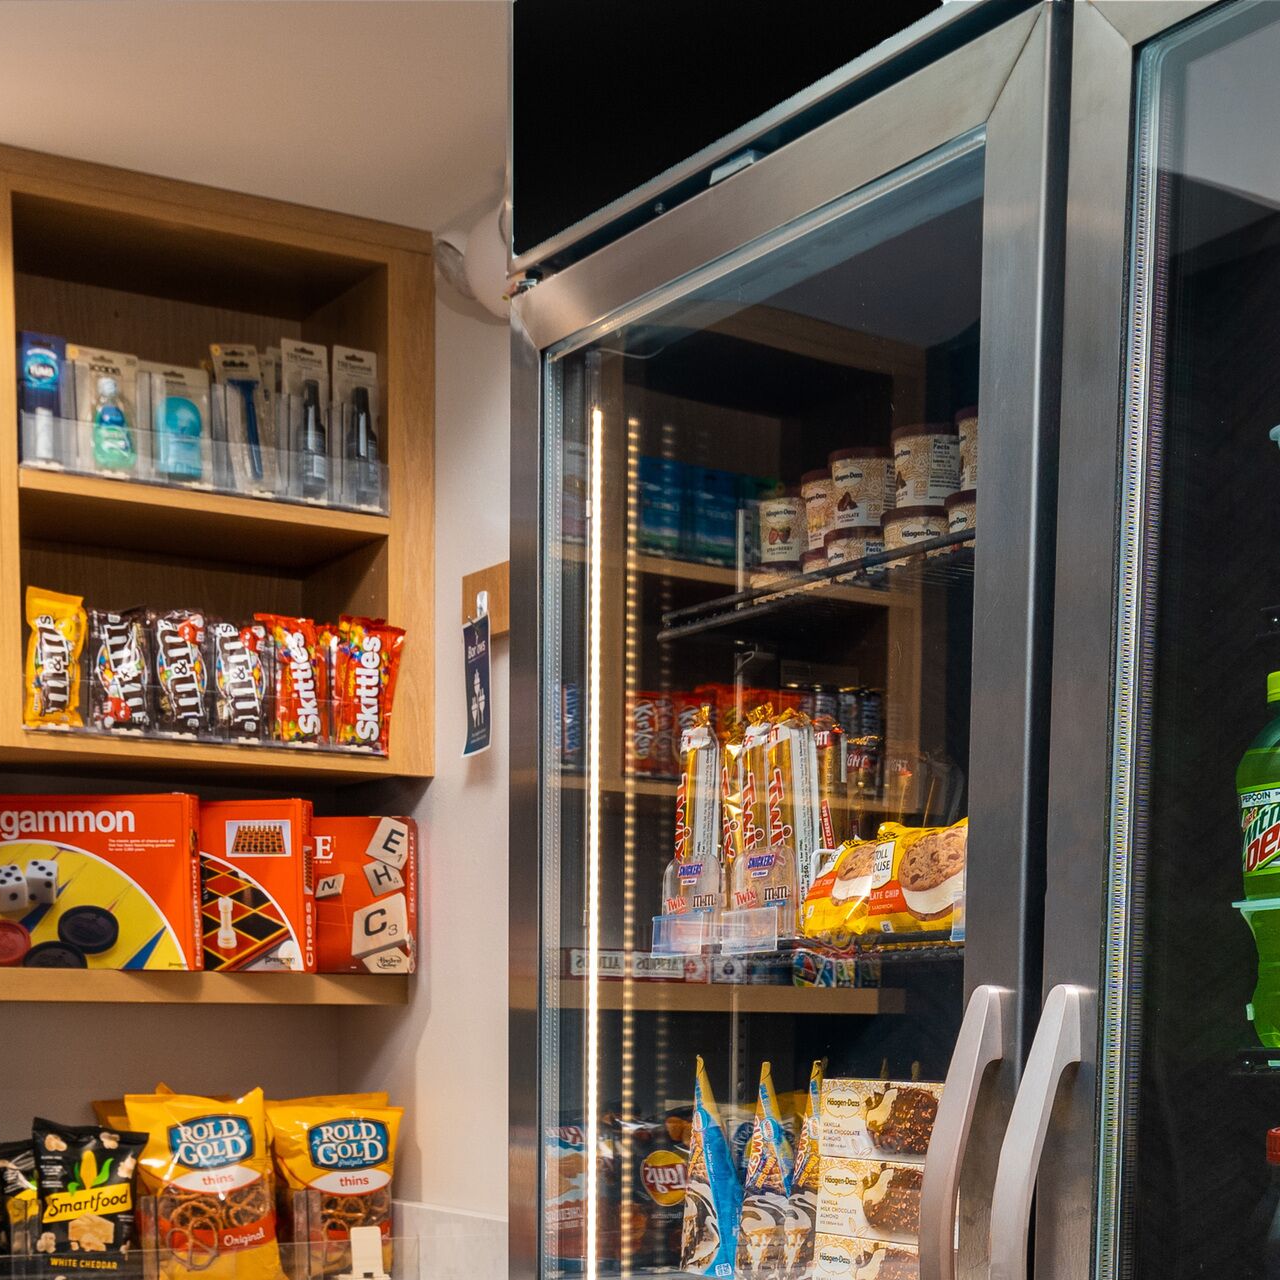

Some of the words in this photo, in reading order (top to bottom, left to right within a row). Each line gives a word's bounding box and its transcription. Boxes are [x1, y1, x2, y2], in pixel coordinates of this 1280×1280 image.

[289, 631, 320, 735] Skittles
[356, 636, 384, 742] Skittles
[748, 854, 775, 869] SNICKERS
[735, 889, 757, 906] Twix
[306, 902, 314, 967] Chess
[180, 1118, 244, 1143] ROLD
[321, 1121, 378, 1142] ROLD
[178, 1137, 248, 1165] GOLD
[317, 1140, 384, 1165] GOLD
[202, 1173, 235, 1186] thins
[339, 1176, 370, 1188] thins
[48, 1190, 128, 1217] Smartfood
[223, 1230, 266, 1247] Original
[50, 1257, 78, 1269] WHITE
[79, 1259, 117, 1271] CHEDDAR
